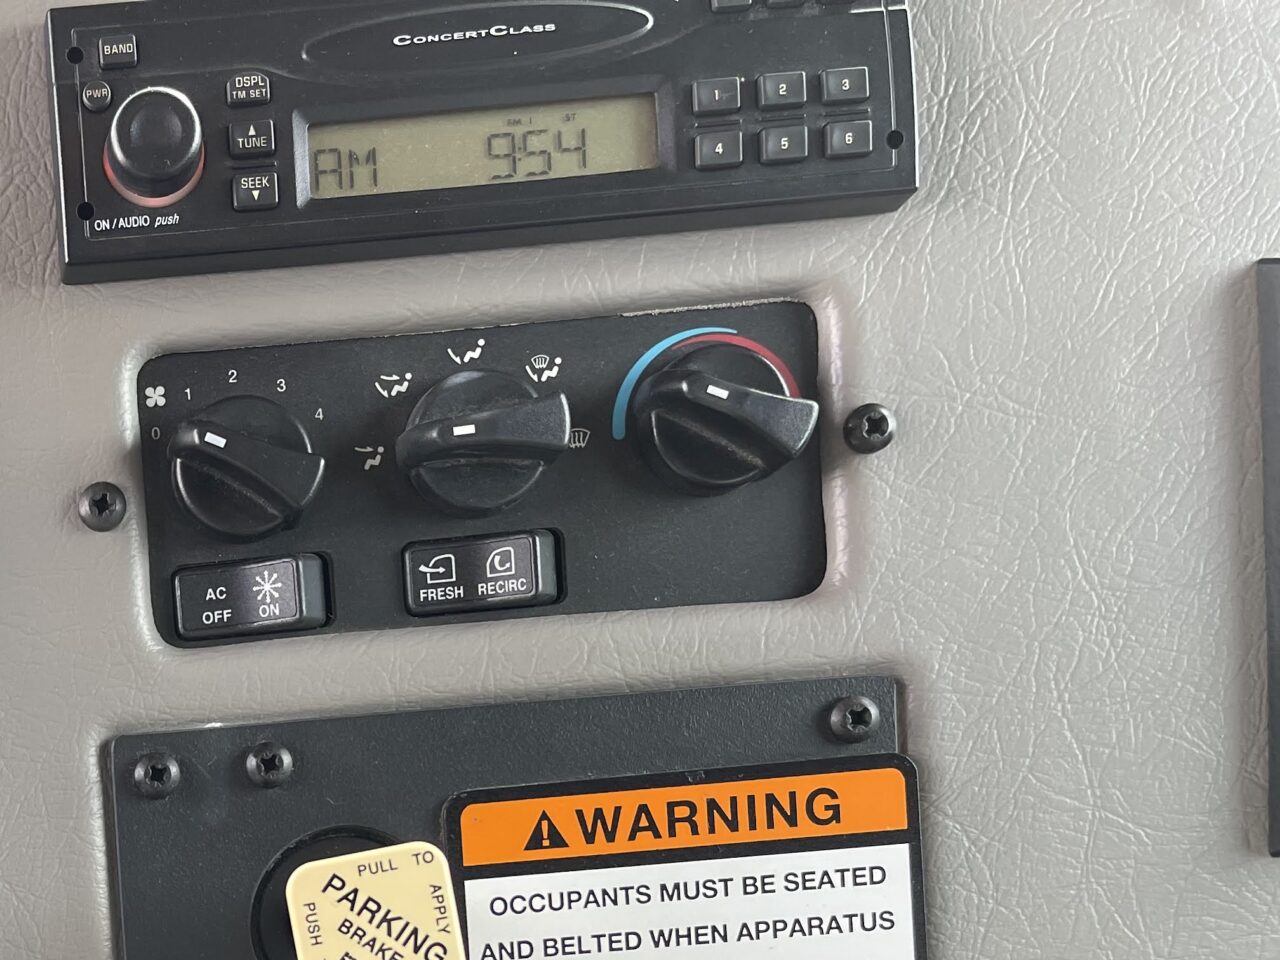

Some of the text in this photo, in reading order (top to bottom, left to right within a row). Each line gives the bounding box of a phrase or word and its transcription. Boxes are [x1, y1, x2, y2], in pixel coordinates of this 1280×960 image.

[104, 44, 133, 55] BAND
[235, 76, 264, 88] DSPL
[842, 79, 850, 91] 3
[86, 88, 108, 98] PWR
[232, 88, 266, 99] TM SET
[713, 89, 720, 100] 1
[778, 84, 787, 95] 2
[237, 136, 267, 149] TUNE
[781, 138, 789, 149] 5
[845, 133, 853, 144] 6
[715, 143, 723, 154] 4
[313, 147, 378, 191] AM
[241, 176, 269, 189] SEEK
[155, 213, 179, 228] push
[228, 370, 237, 383] 2
[276, 379, 286, 392] 3
[184, 388, 191, 400] 1
[315, 408, 324, 421] 4
[151, 427, 160, 440] 0
[205, 586, 227, 601] AC
[478, 578, 527, 596] RECIRC
[420, 586, 464, 602] FRESH
[202, 609, 232, 625] OFF
[259, 604, 280, 618] ON
[574, 786, 842, 845] WARNING
[357, 850, 451, 934] PULL TO APPLY
[489, 865, 887, 916] OCCUPANTS MUST BE SEATED
[303, 902, 323, 946] PUSH
[542, 930, 643, 958] BELTED
[649, 924, 729, 949] WHEN
[736, 910, 896, 942] APPARATUS
